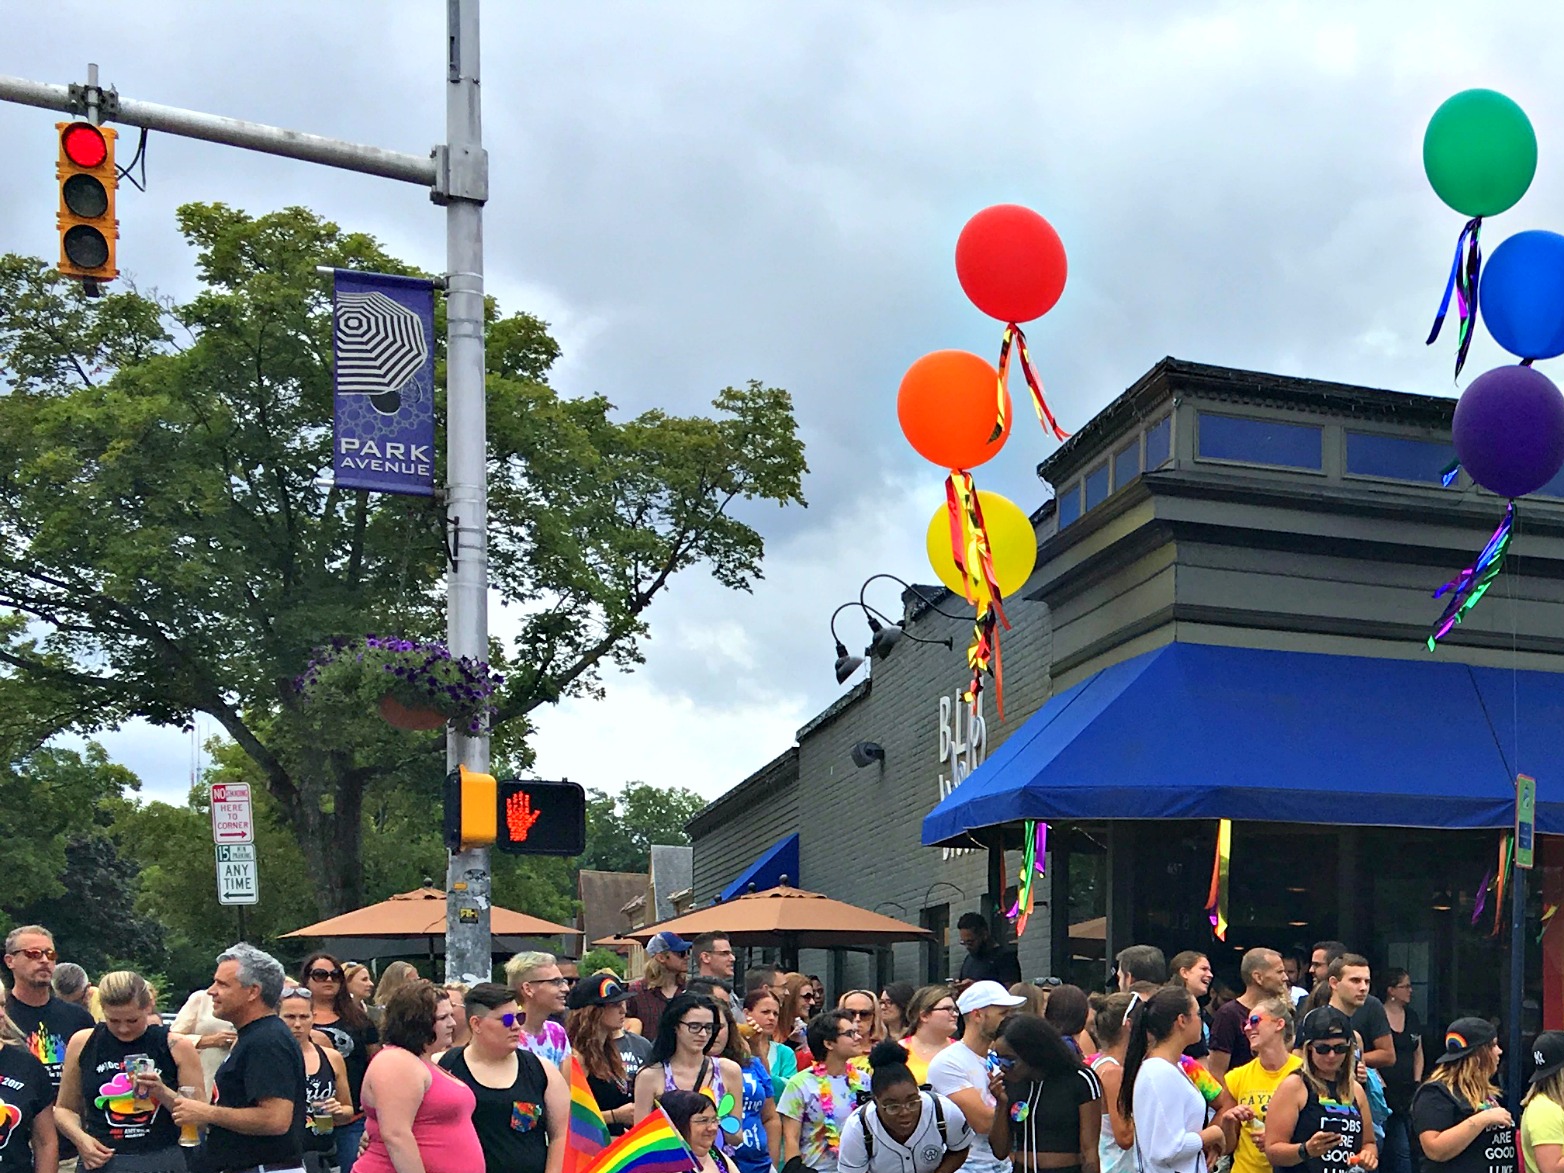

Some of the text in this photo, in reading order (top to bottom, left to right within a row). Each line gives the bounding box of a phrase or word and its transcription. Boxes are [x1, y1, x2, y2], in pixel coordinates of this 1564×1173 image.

[340, 438, 430, 463] PARK
[340, 457, 430, 476] AVENUE
[213, 788, 226, 800] NO
[220, 803, 243, 812] HERE
[217, 821, 249, 830] CORNER
[218, 846, 230, 861] 15
[225, 864, 249, 876] ANY
[223, 878, 252, 890] TIME
[1339, 1135, 1354, 1148] RE
[1492, 1131, 1512, 1145] ARE
[1485, 1146, 1515, 1160] GOOD
